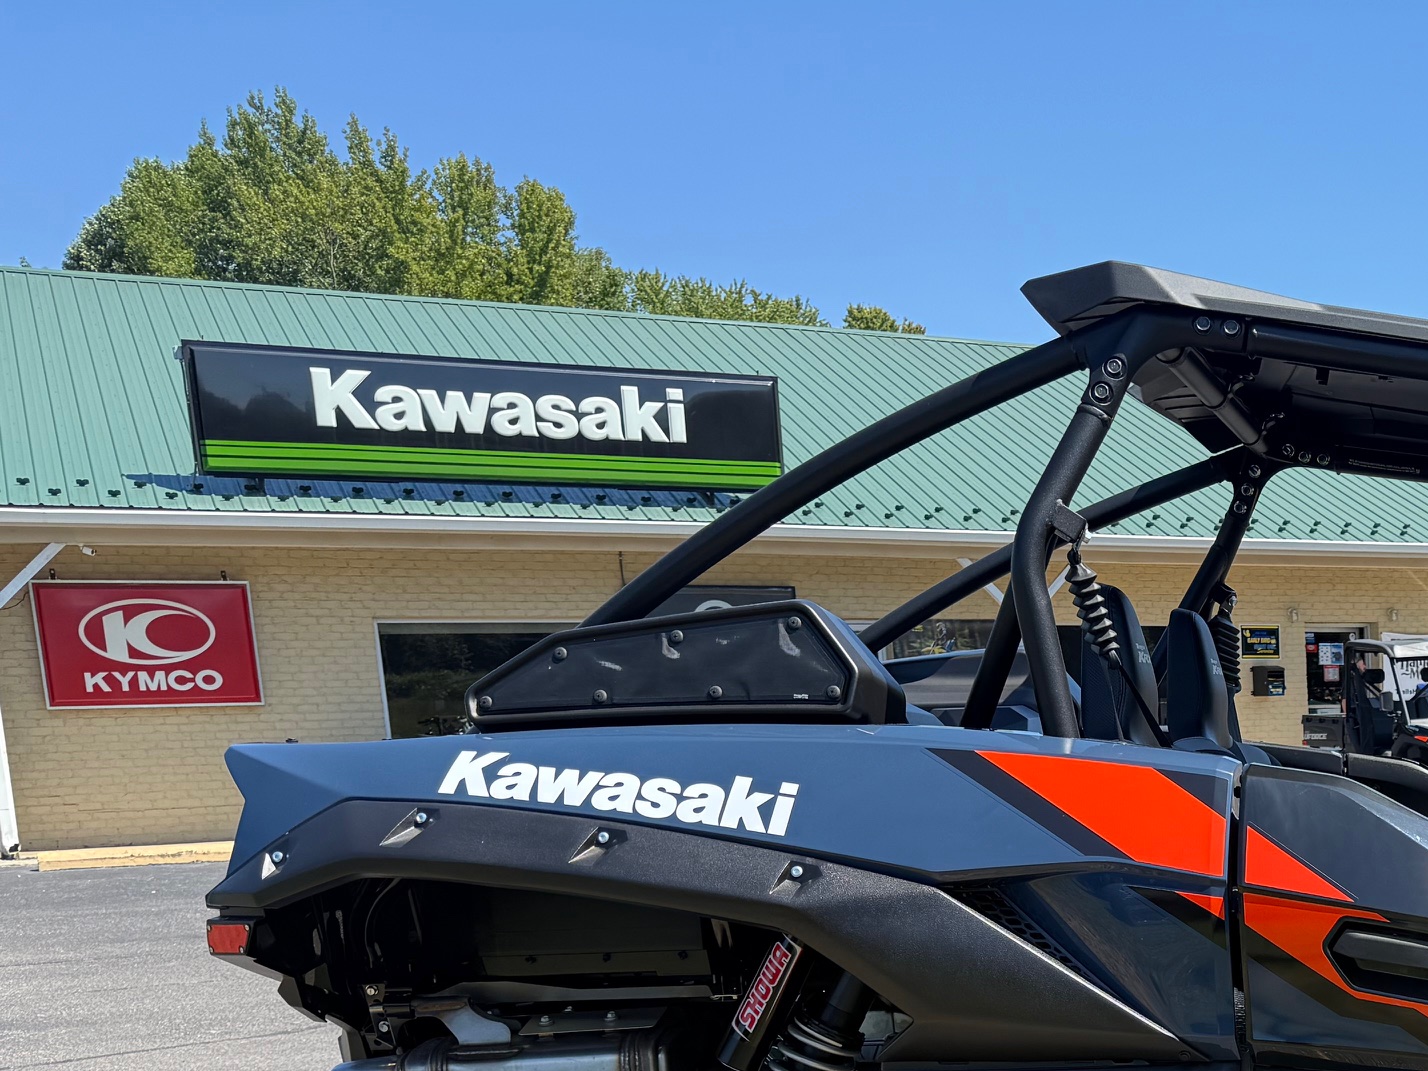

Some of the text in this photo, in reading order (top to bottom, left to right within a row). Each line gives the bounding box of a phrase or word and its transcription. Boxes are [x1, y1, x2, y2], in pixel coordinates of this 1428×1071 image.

[309, 366, 688, 444] Kawasaki
[83, 669, 223, 692] KYMCO
[437, 750, 800, 837] Kawasaki
[739, 941, 792, 1034] SHOWA
